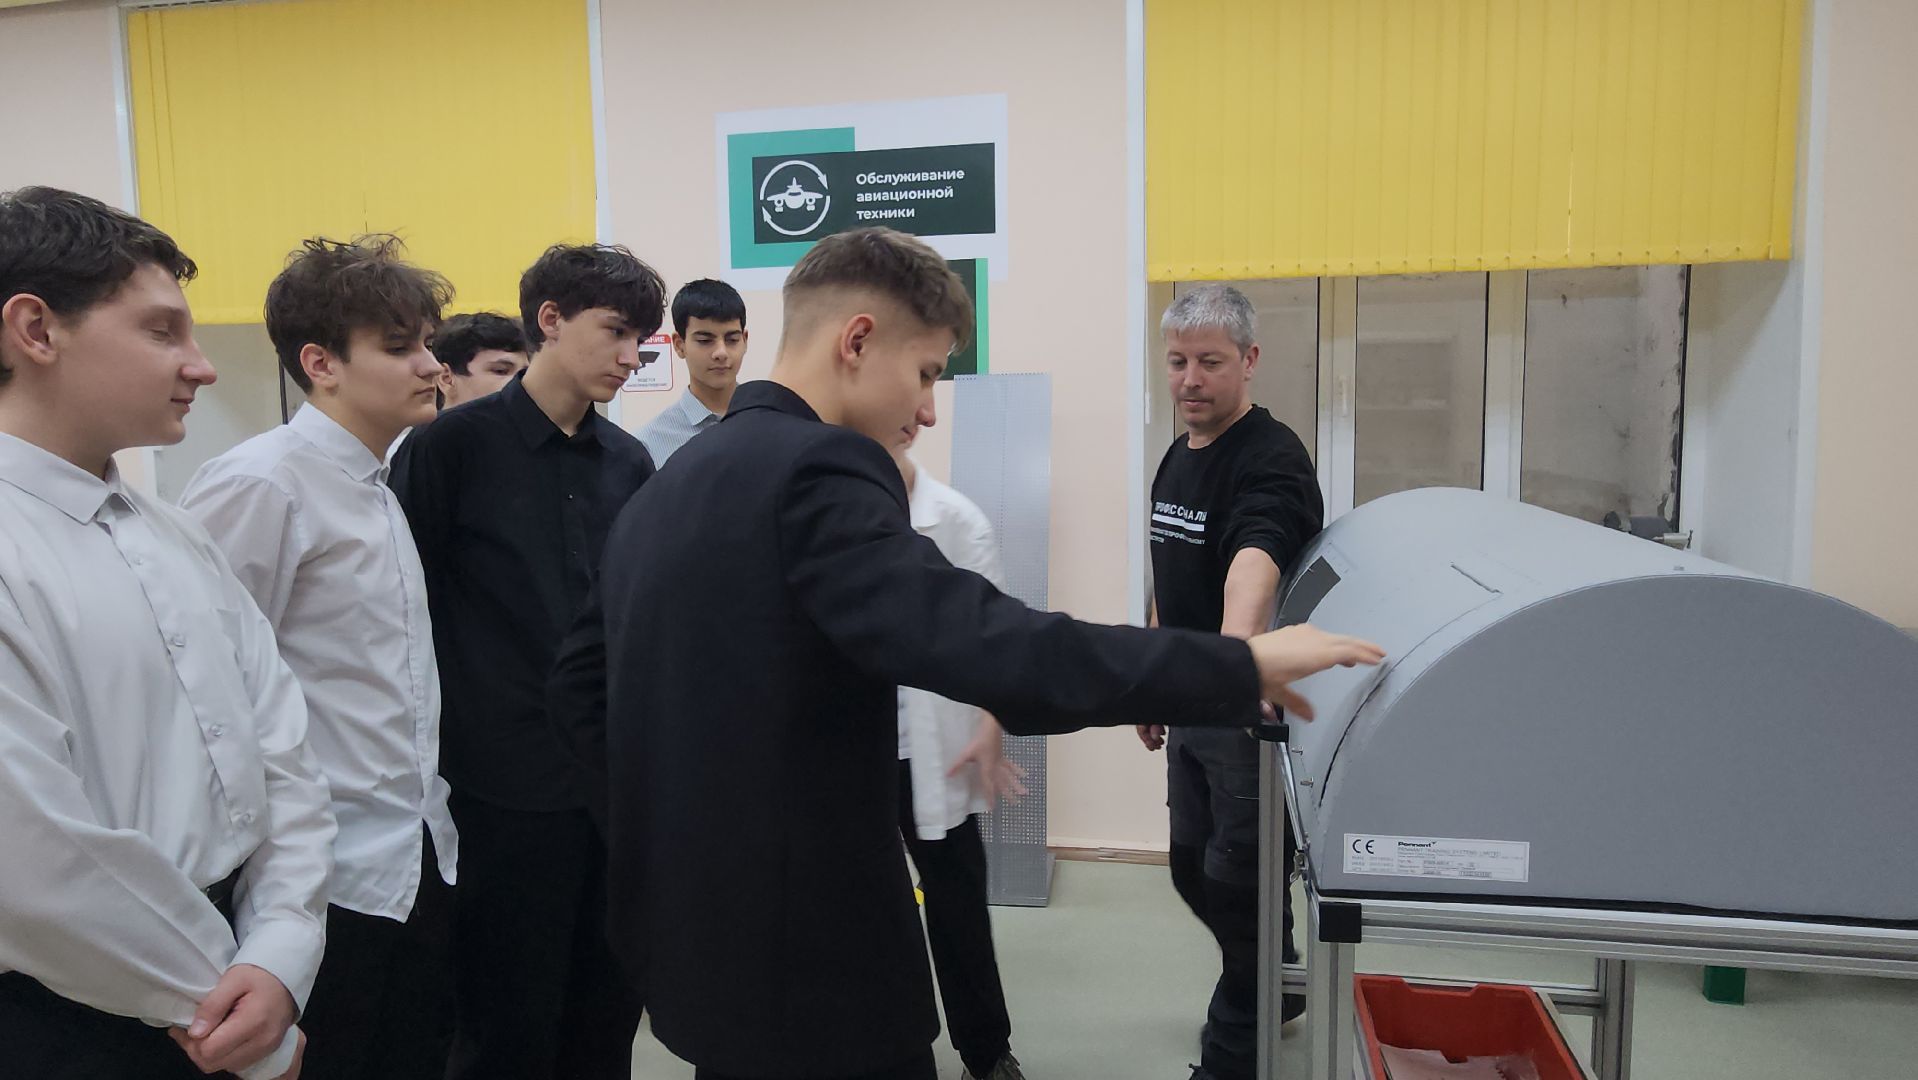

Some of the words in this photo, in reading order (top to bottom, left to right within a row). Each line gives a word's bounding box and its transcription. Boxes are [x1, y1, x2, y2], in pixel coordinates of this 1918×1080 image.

[856, 170, 965, 185] Обслуживание
[856, 186, 954, 202] авиационной
[856, 208, 915, 220] техники
[1352, 839, 1375, 855] CE
